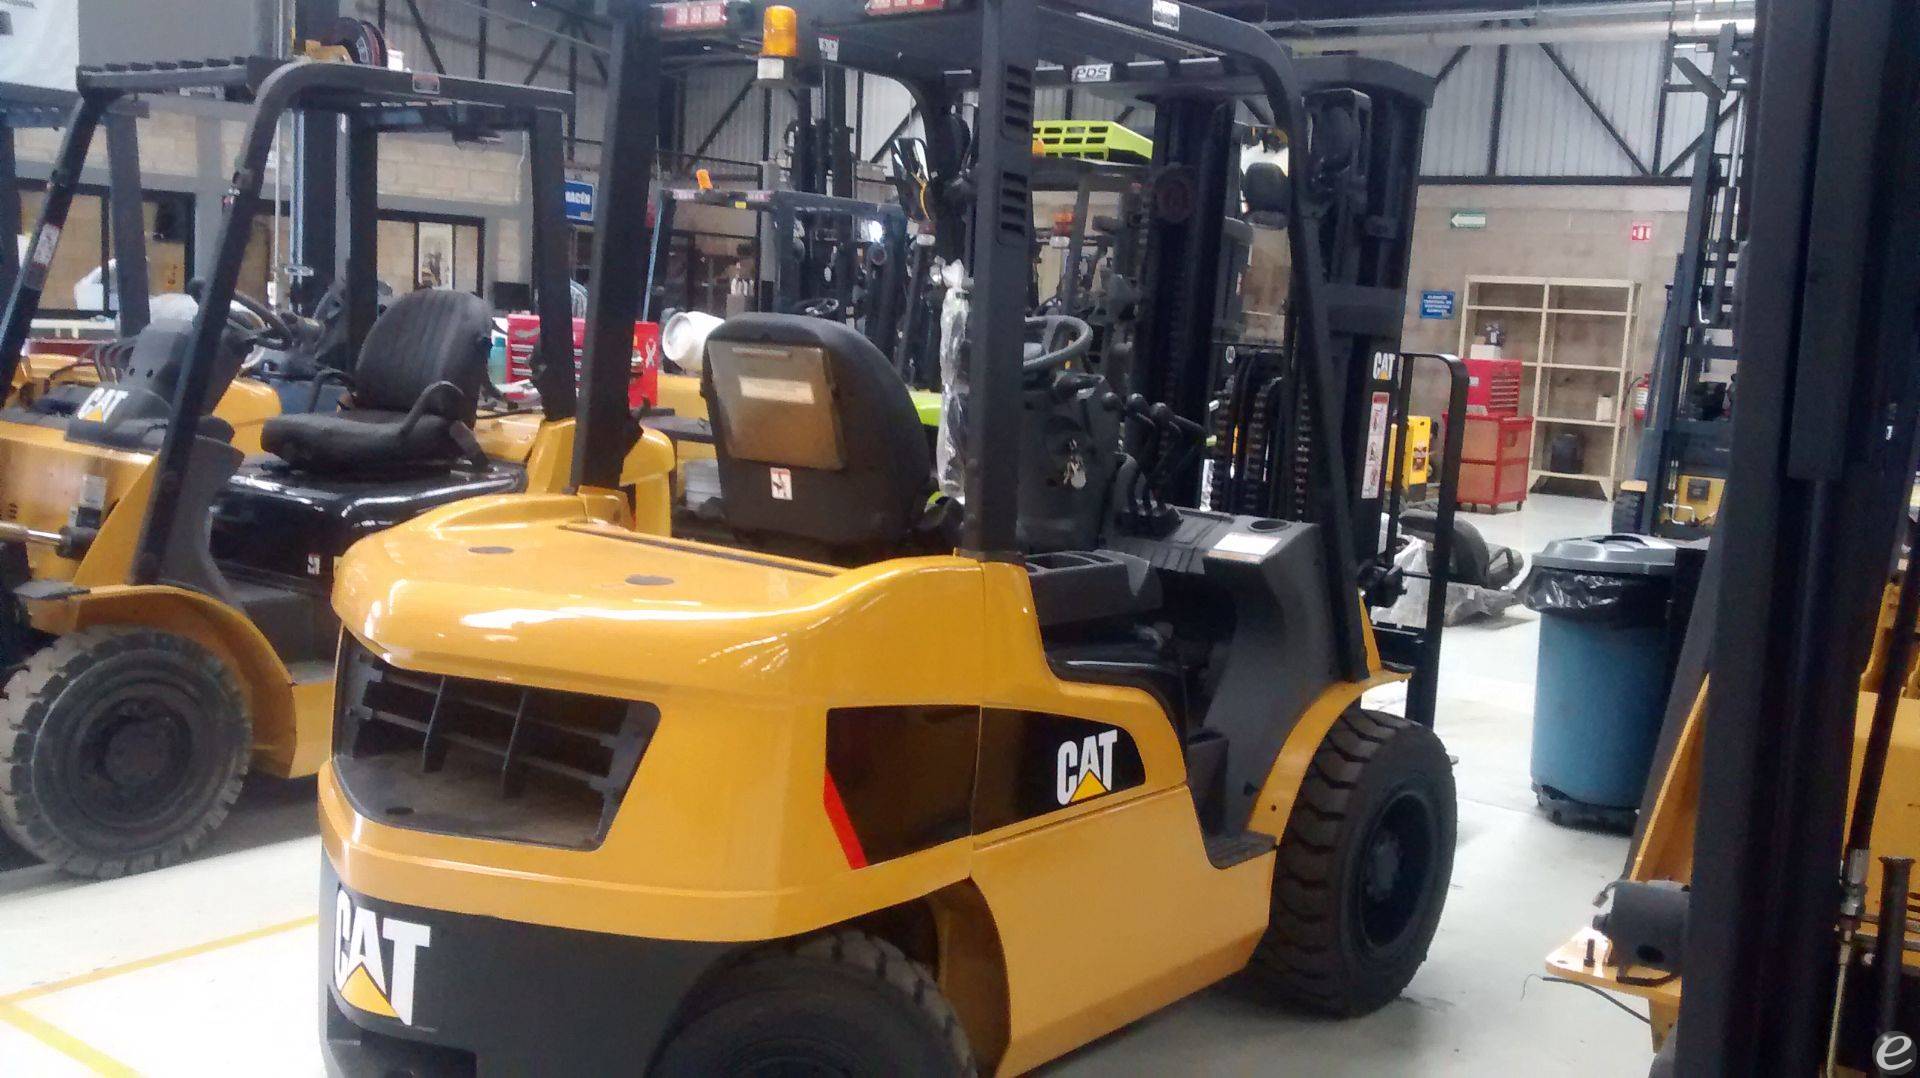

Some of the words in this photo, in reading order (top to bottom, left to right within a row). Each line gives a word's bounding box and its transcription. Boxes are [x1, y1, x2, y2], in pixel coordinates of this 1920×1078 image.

[1373, 351, 1396, 380] CAT
[77, 387, 129, 423] CAT
[1056, 729, 1118, 805] CAT
[334, 889, 431, 1026] CAT
